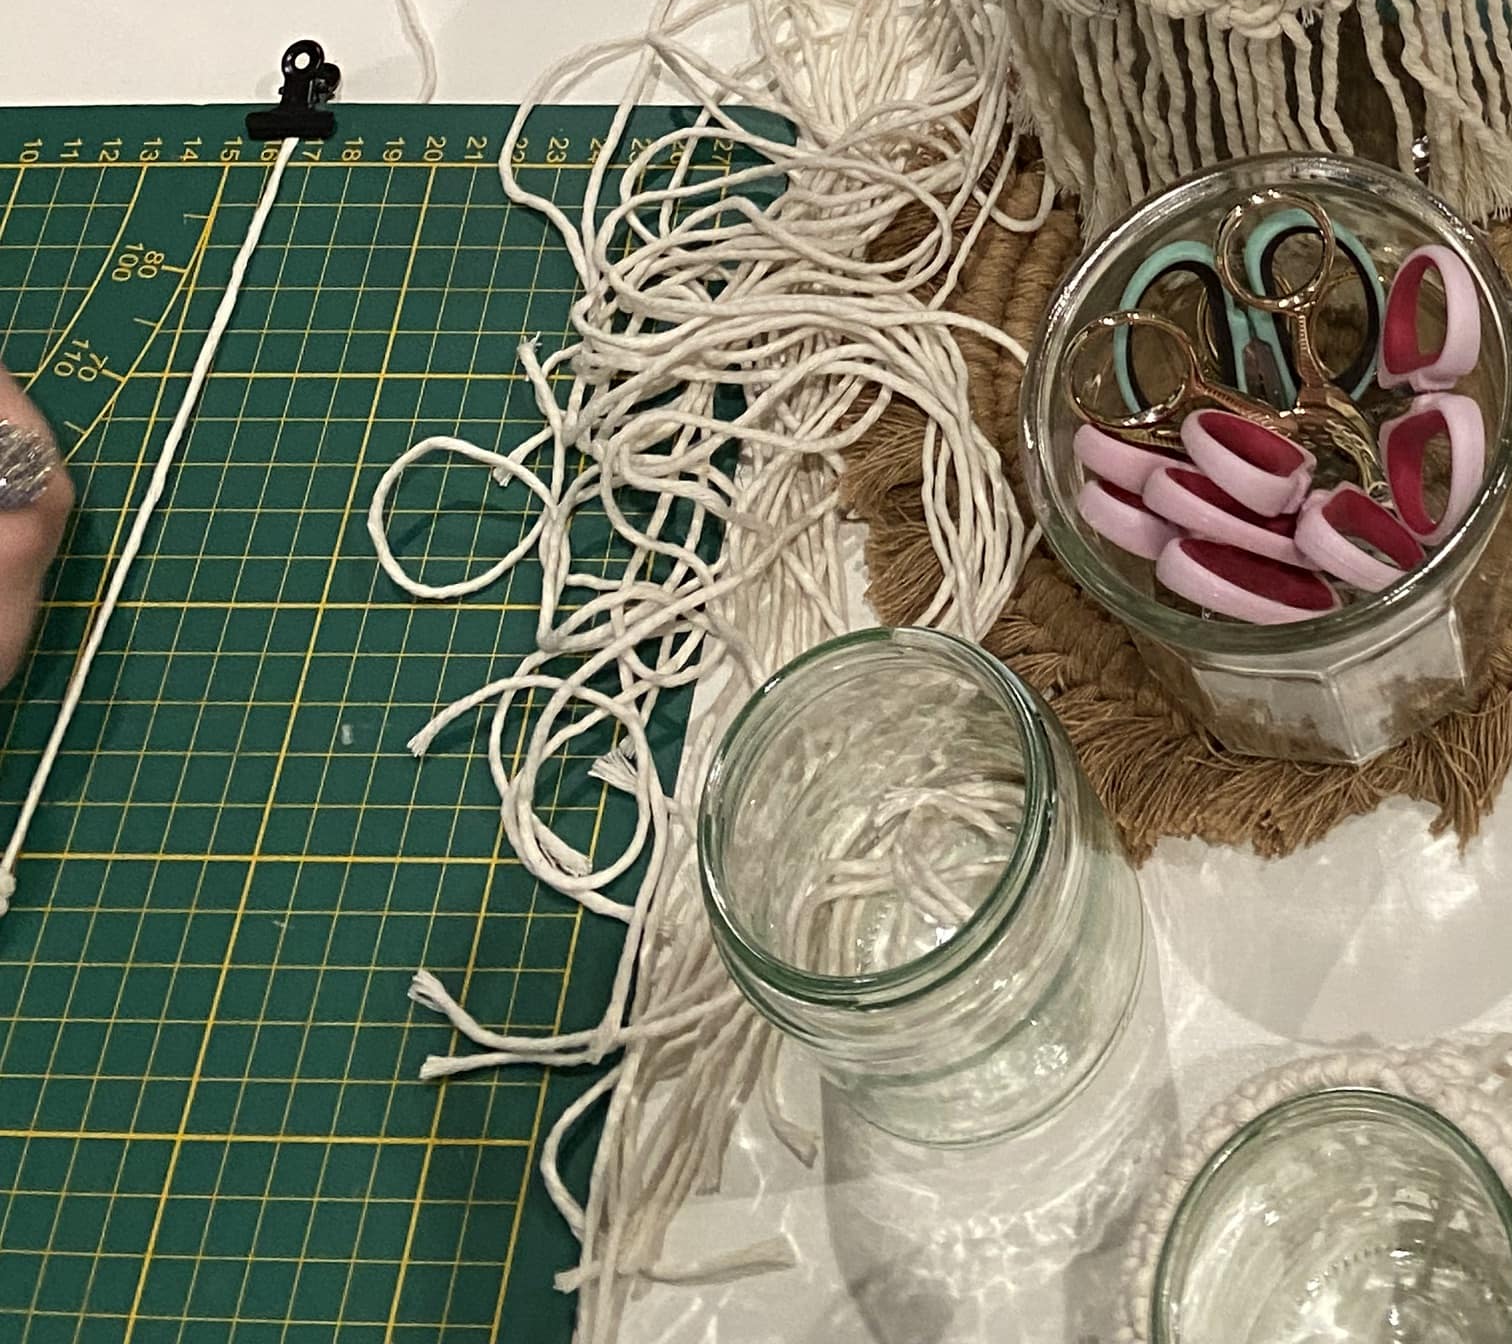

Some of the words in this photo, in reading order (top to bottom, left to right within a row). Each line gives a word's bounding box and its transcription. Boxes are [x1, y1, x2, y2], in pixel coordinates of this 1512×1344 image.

[18, 138, 44, 164] 10
[59, 137, 84, 161] 11
[98, 137, 123, 163] 12
[139, 137, 164, 163] 13
[179, 136, 203, 162] 14
[219, 136, 244, 162] 15
[340, 135, 365, 163] 18
[381, 136, 406, 163] 19
[424, 135, 448, 162] 20
[463, 135, 489, 161] 21
[546, 136, 571, 163] 23
[111, 241, 146, 282] 100
[137, 250, 166, 280] 80
[53, 338, 90, 378] 110
[77, 351, 110, 383] 70
